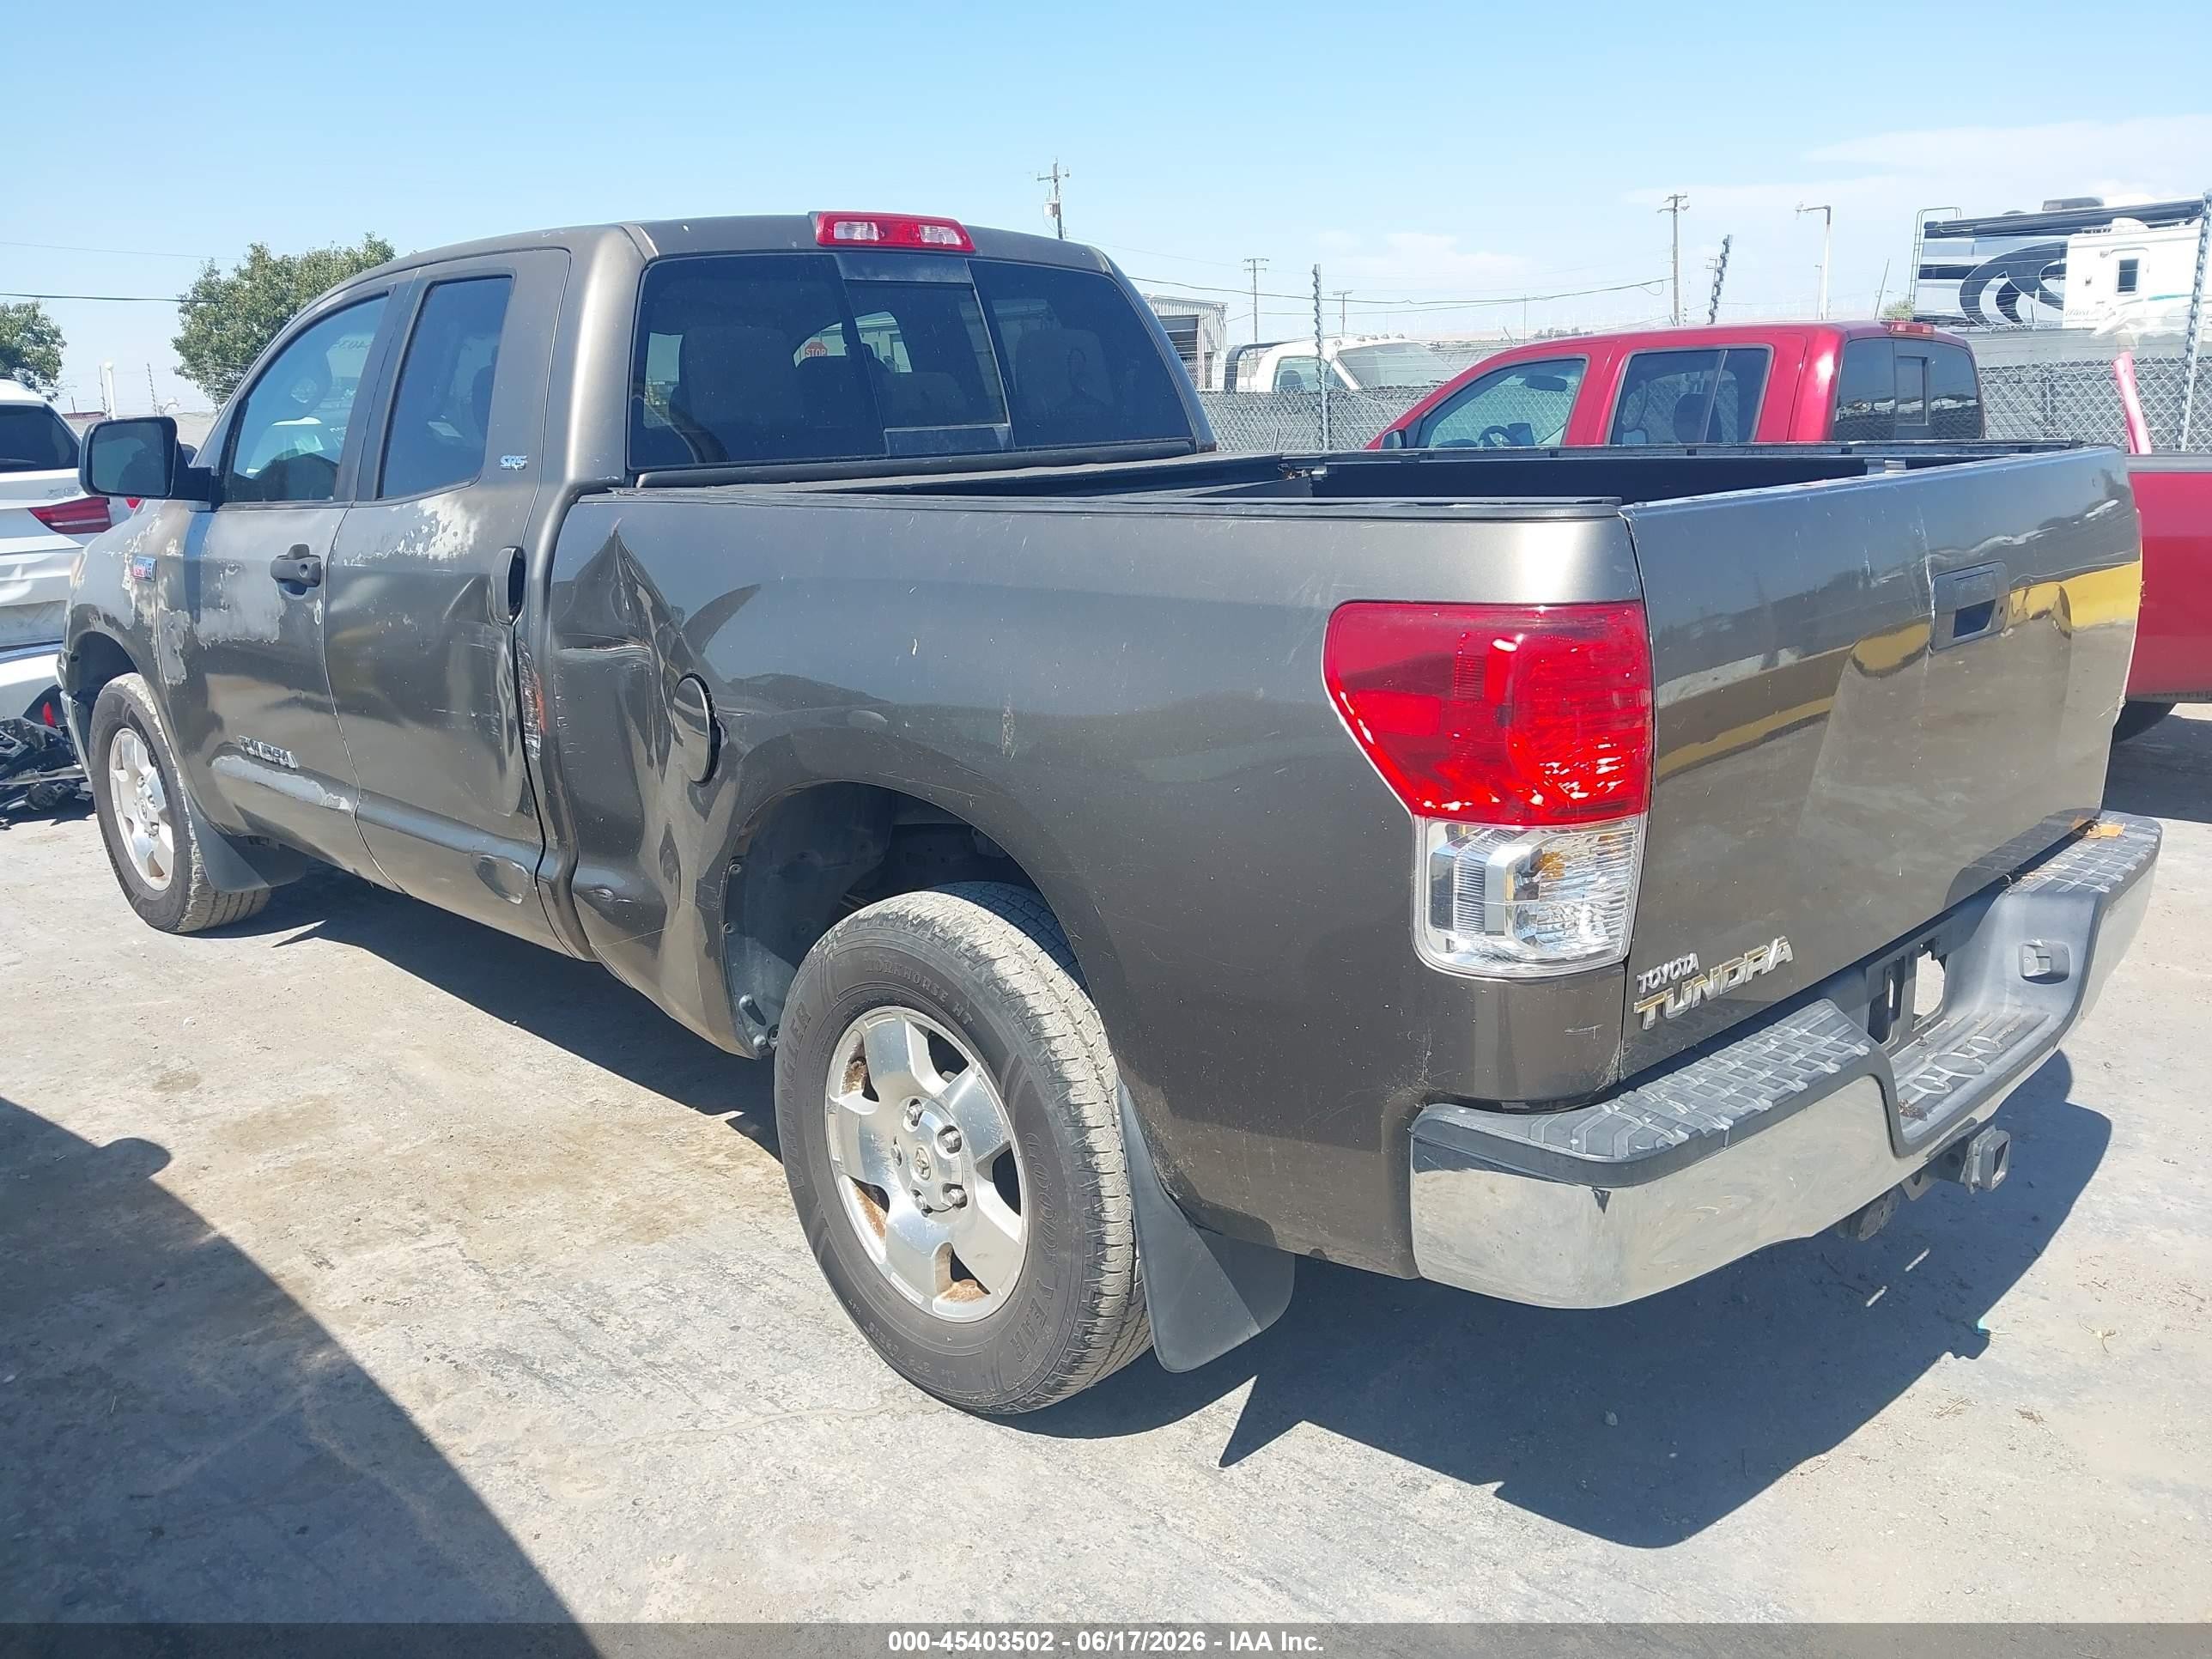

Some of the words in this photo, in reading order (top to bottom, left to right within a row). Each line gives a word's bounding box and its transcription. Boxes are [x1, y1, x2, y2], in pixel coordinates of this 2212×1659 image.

[805, 349, 826, 357] STOP
[1633, 934, 1795, 1030] TUNDRA
[1637, 952, 1700, 994] TOYOTA
